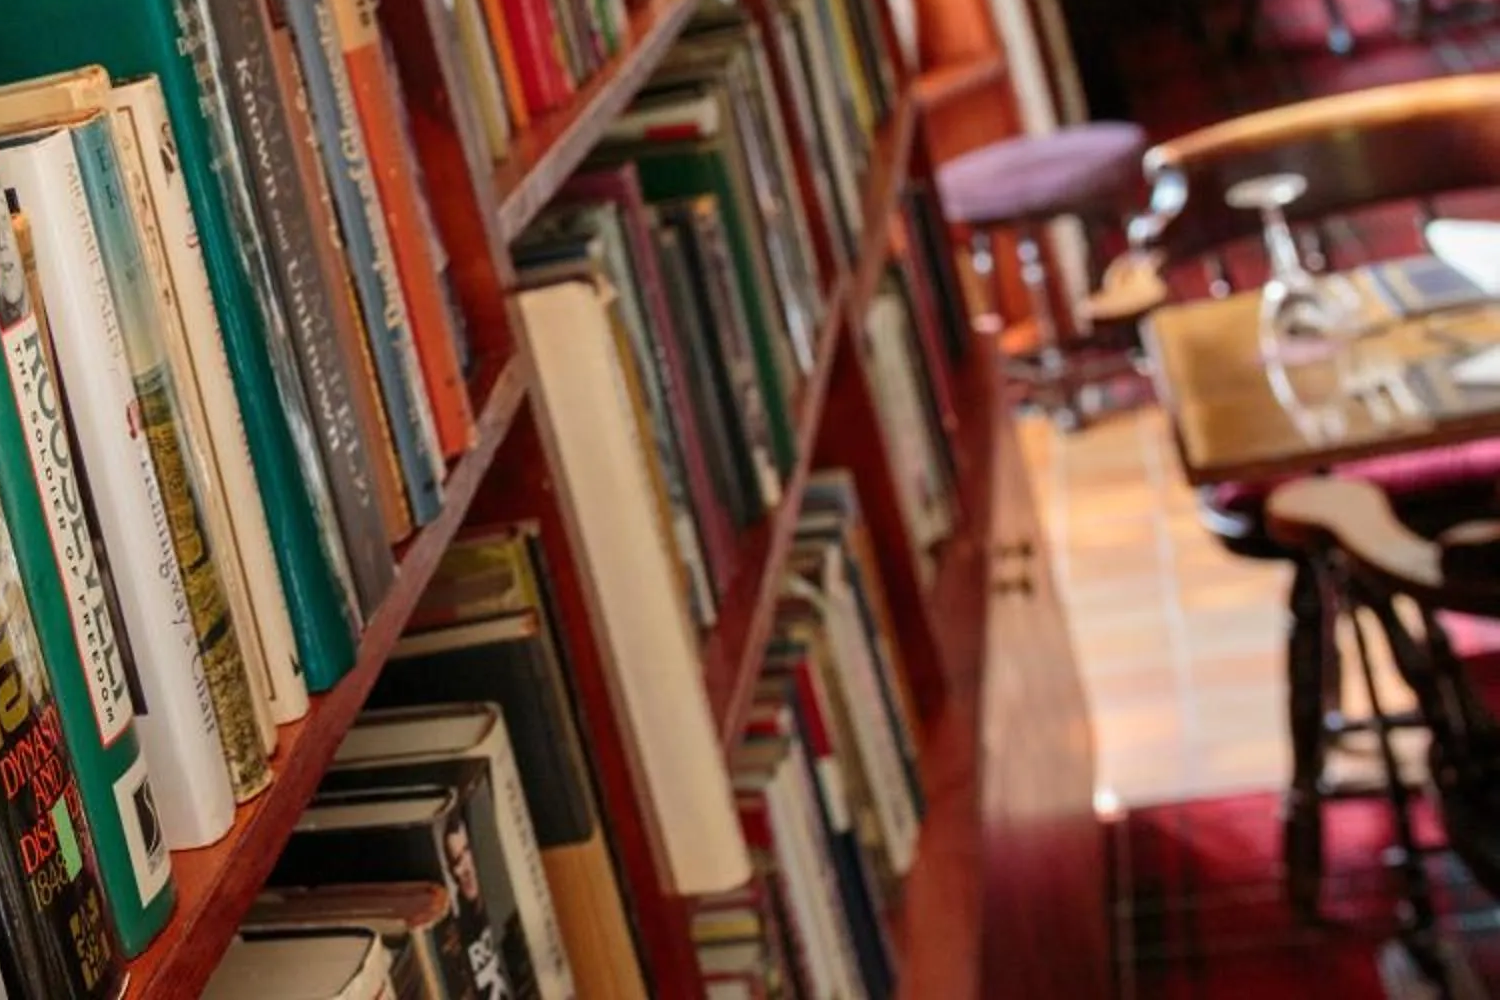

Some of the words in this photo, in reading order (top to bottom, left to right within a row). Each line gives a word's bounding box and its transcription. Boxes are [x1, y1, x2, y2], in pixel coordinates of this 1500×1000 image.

[236, 56, 278, 204] Known
[286, 259, 340, 451] Unknown
[13, 343, 32, 395] THE
[30, 410, 67, 531] SOLDIER
[64, 545, 82, 578] OF
[77, 593, 115, 725] FREEDOM
[30, 753, 65, 812] AND
[189, 650, 216, 735] Chair
